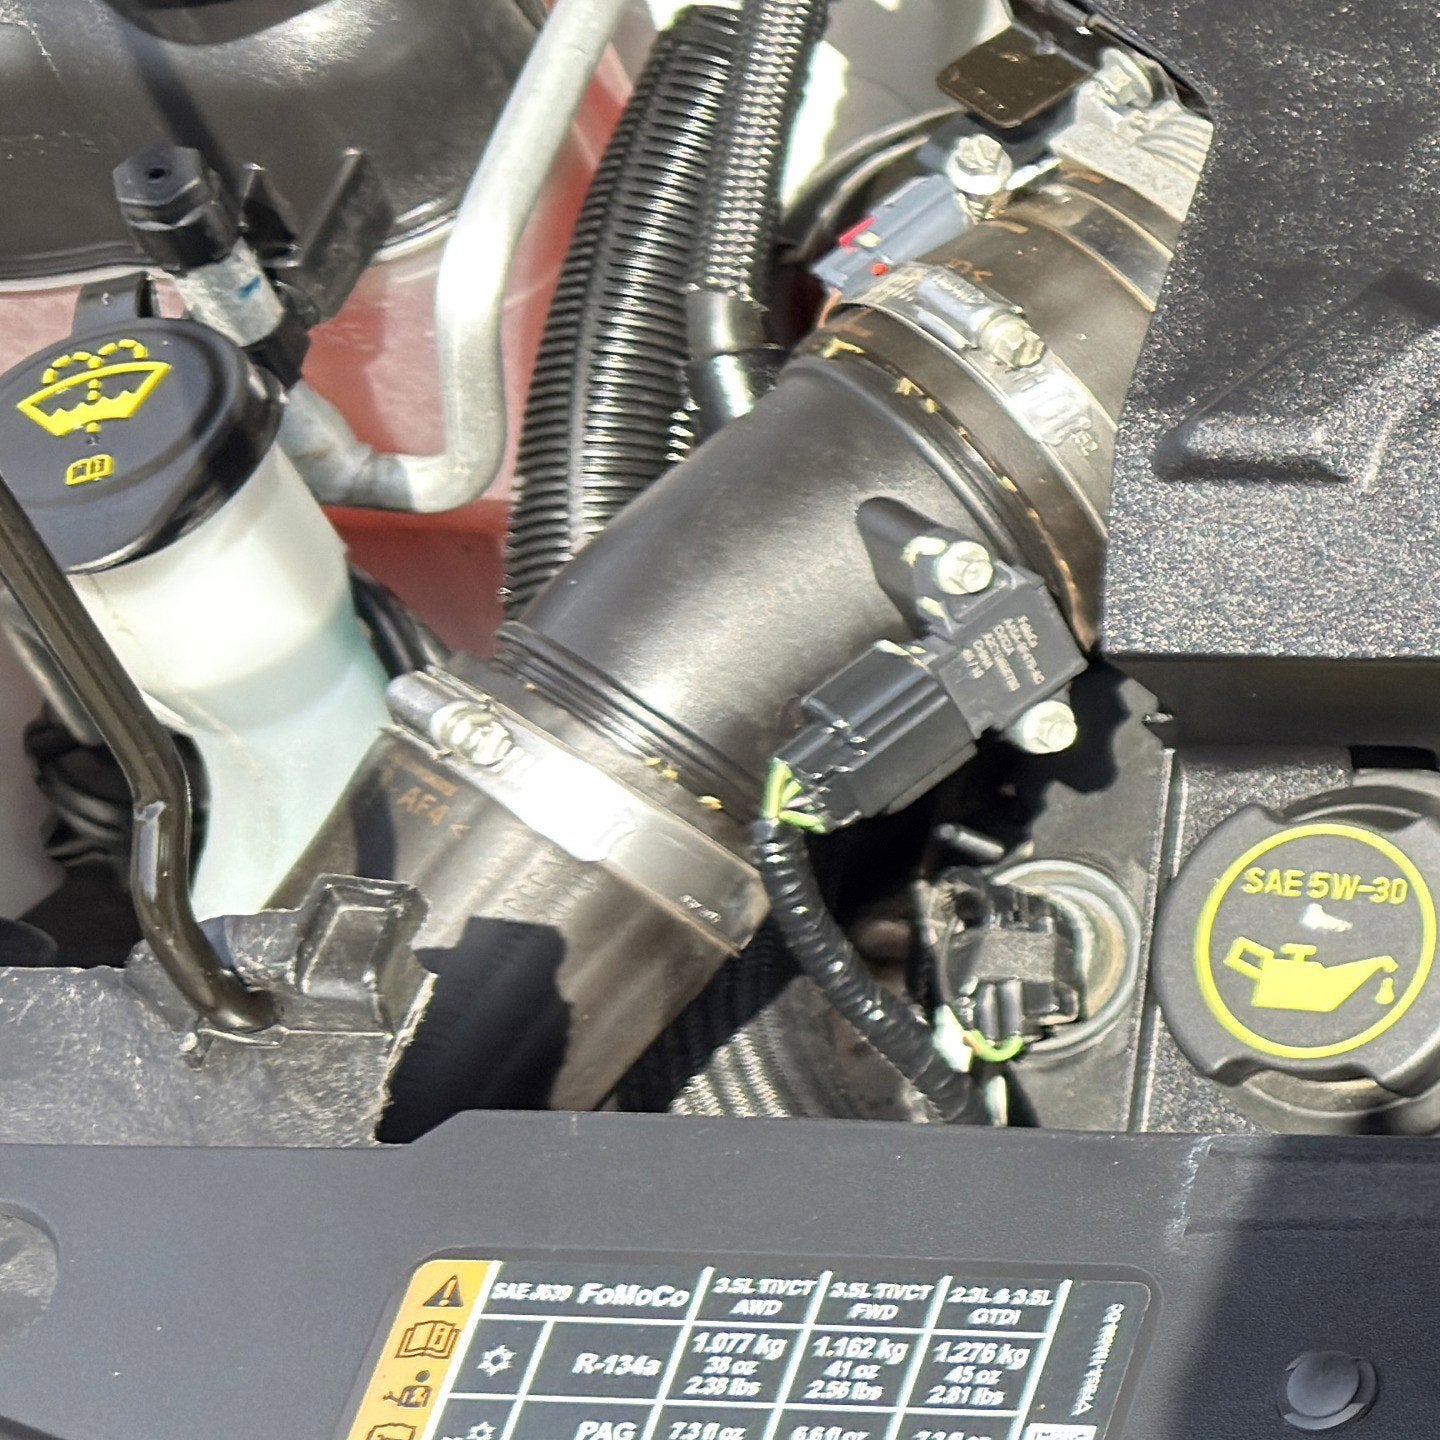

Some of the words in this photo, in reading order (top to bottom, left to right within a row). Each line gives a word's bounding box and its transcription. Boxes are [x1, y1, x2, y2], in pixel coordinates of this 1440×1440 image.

[1241, 867, 1305, 898] SAE
[1307, 871, 1410, 905] 5W-30
[491, 1283, 529, 1300] SAE
[577, 1283, 690, 1307] FoMoCo
[713, 1277, 755, 1295] 3.5L
[829, 1282, 872, 1299] 3.5L
[1010, 1288, 1054, 1305] 3.5L
[730, 1299, 783, 1316] AWD
[848, 1303, 899, 1321] FWD
[692, 1332, 755, 1353] 1.077
[753, 1333, 788, 1360] kg
[812, 1336, 876, 1358] 1.162
[876, 1338, 909, 1365] kg
[933, 1341, 997, 1363] 1.276
[996, 1343, 1031, 1370] kg
[572, 1352, 663, 1376] R-134a
[731, 1360, 760, 1375] oz
[823, 1360, 852, 1379] 41
[852, 1364, 882, 1380] oz
[944, 1365, 976, 1384] 45
[974, 1370, 1002, 1385] oz
[727, 1378, 762, 1397] lbs
[803, 1379, 850, 1399] 2.56
[850, 1381, 884, 1400] lbs
[925, 1385, 970, 1404] 2.81
[971, 1387, 1006, 1406] lbs
[669, 1421, 702, 1440] 7.3
[702, 1422, 720, 1440] fl
